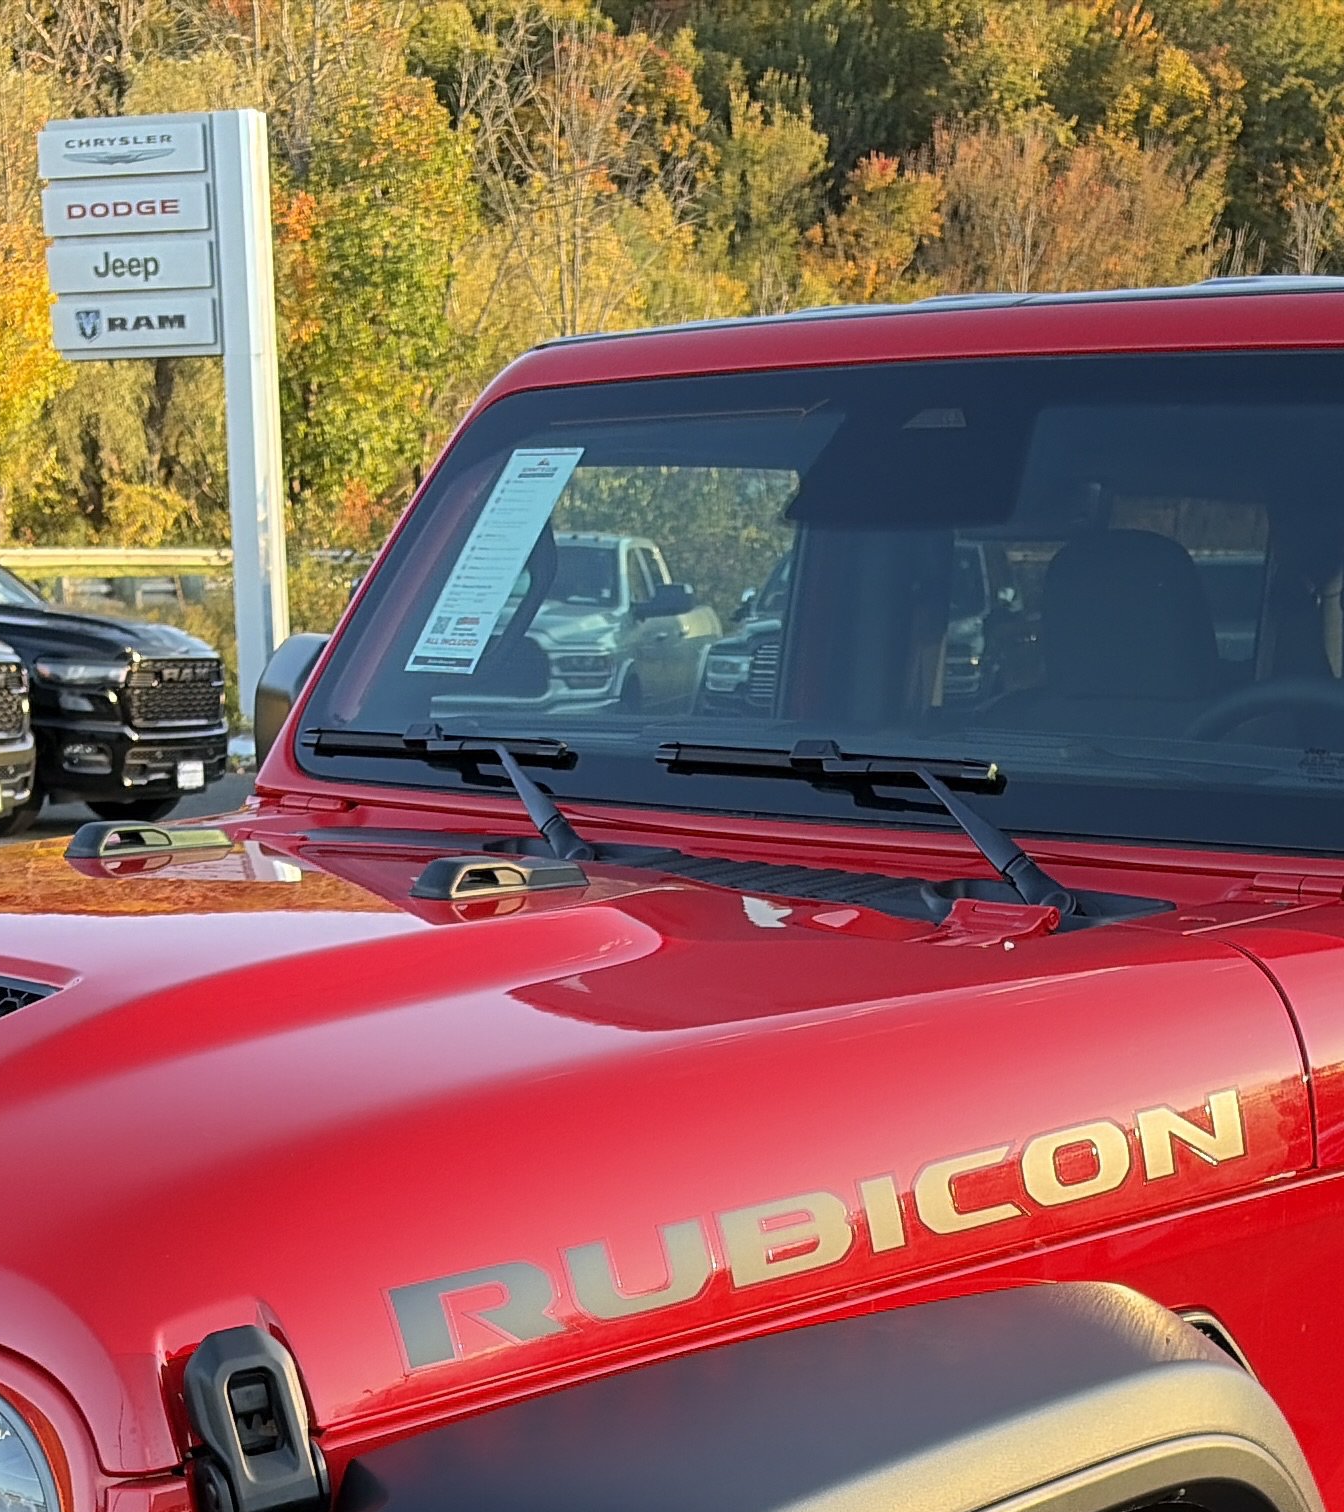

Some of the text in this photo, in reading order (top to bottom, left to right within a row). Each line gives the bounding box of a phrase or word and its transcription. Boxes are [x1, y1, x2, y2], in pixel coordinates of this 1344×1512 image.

[64, 134, 173, 149] CHRYSLER
[66, 199, 181, 220] DODGE
[93, 251, 160, 282] Jeep
[107, 314, 186, 332] RAM
[161, 667, 211, 682] RAM
[381, 1086, 1248, 1376] RUBICON
